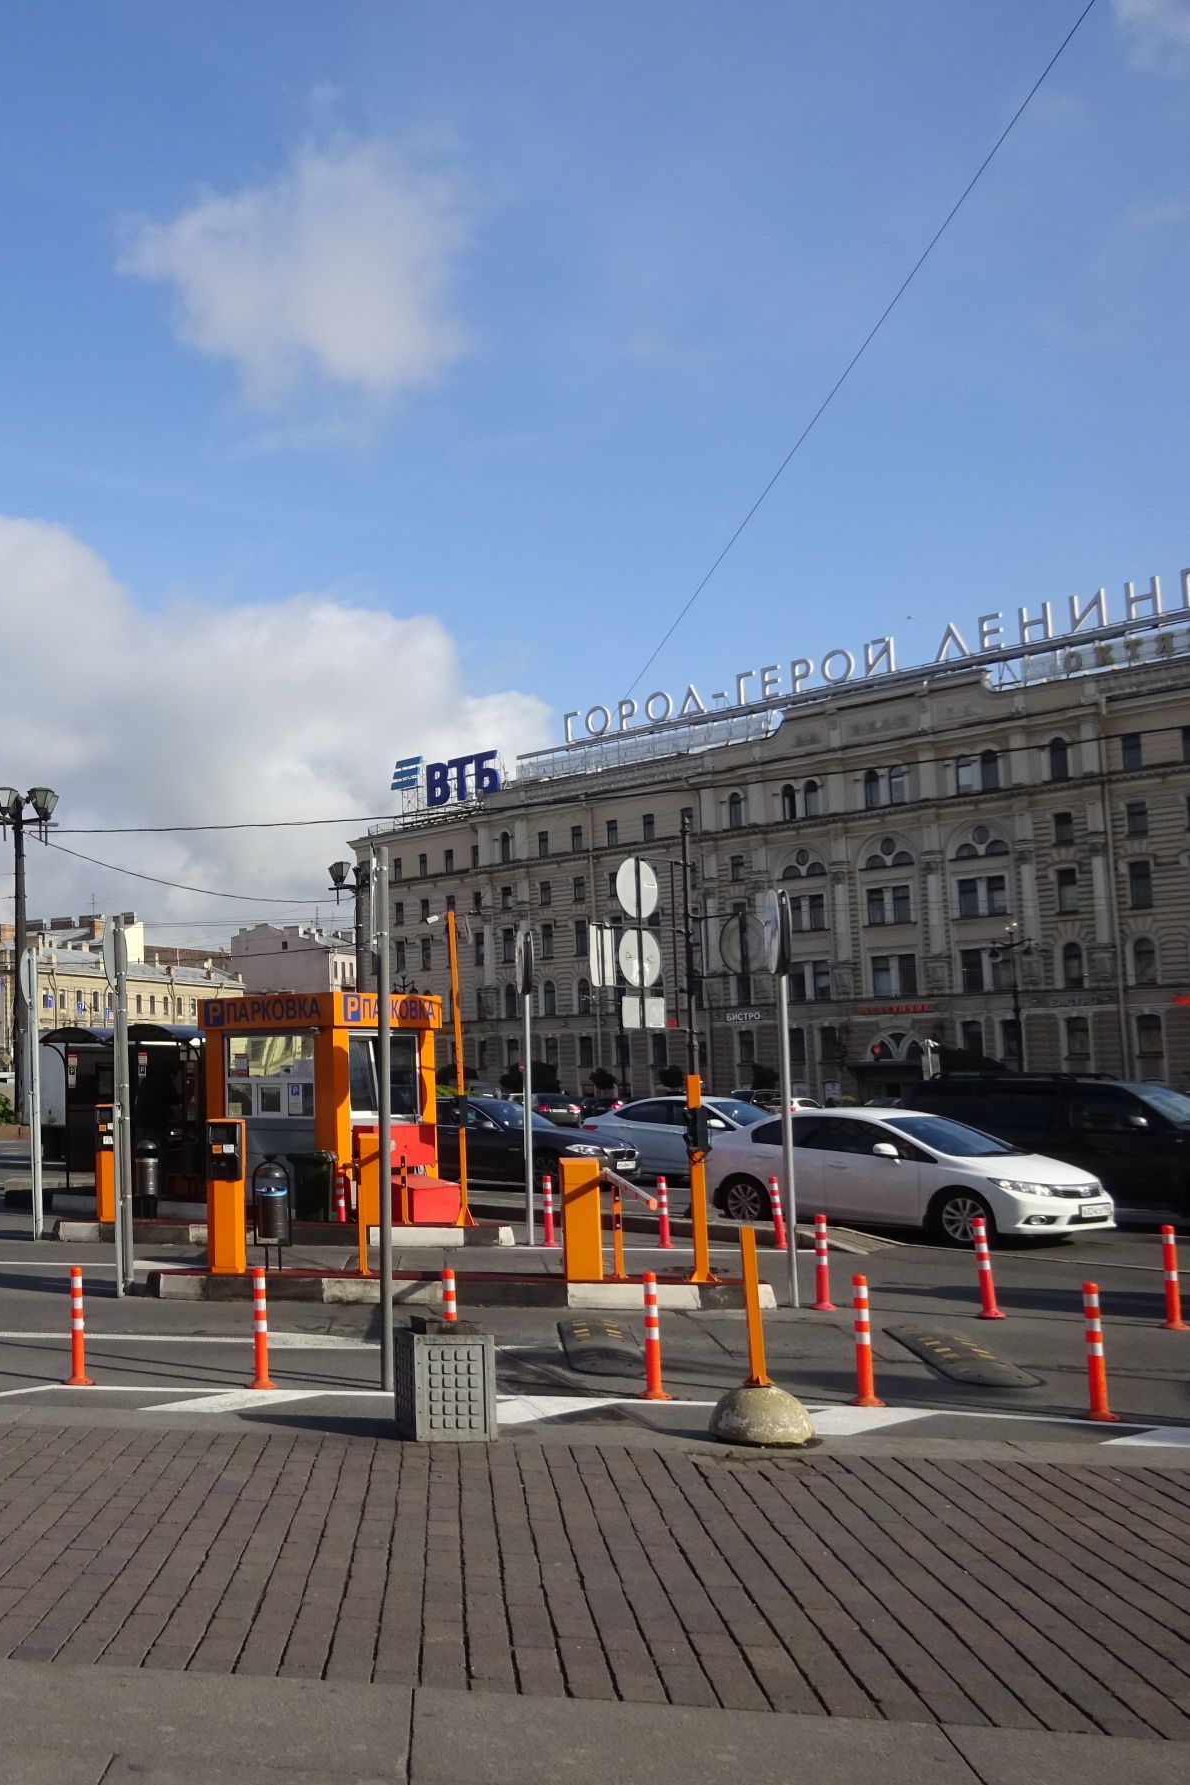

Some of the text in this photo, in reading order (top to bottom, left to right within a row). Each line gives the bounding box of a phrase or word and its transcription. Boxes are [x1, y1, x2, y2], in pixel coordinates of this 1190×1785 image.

[1064, 627, 1190, 674] ОКТЯ
[563, 636, 898, 744] ГОРОД-ГЕРОЙ
[426, 749, 501, 808] ВТБ
[226, 996, 321, 1024] ПАРКОВКА
[363, 998, 436, 1021] ПАКОВКА
[726, 1011, 761, 1022] БИСТРО
